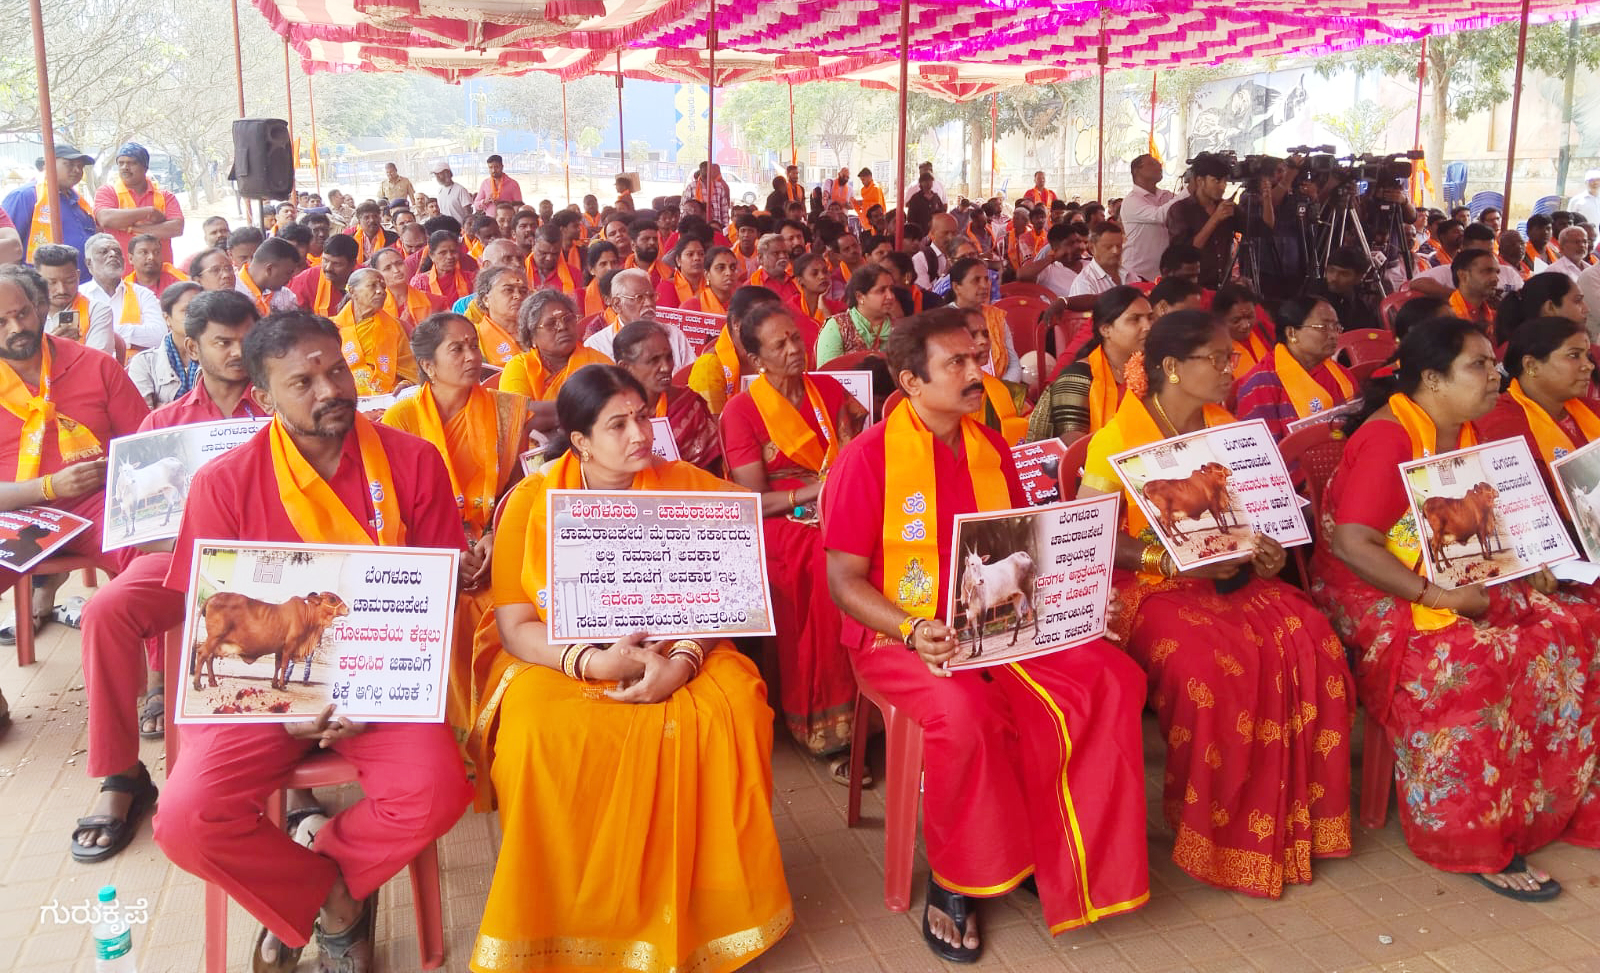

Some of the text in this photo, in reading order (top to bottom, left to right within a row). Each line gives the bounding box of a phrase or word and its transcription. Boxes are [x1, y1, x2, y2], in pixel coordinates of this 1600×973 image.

[572, 501, 637, 518] ಬೆಂಗಳೂರು
[659, 502, 739, 519] ಚಾಮರಾಜಪೇಟೆ
[1059, 508, 1099, 524] ಬೆಂಗಳೂರು
[560, 525, 643, 540] ಚಾಮರಾಜಪೇಟೆ
[649, 526, 690, 547] ಮೈದಾನ
[1051, 523, 1103, 545] ಚಾಮರಾಜಪೇಟೆ
[678, 549, 720, 562] ಅವಕಾಶ
[365, 565, 422, 585] ಬೆಂಗಳೂರು
[580, 568, 737, 586] ಗಣೇಶ ಪೂಜೆಗೆ ಅವಕಾಶ ಇಲ್ಲ
[353, 595, 429, 614] ಚಾಮರಾಜಪೇಟೆ
[601, 590, 643, 606] ಇದೇನಾ
[614, 611, 688, 626] ಮಹಾಶಯರೇ
[334, 622, 440, 652] ಗೋಮಾತೆಯ ಕೆಚ್ಚಲು
[1035, 631, 1060, 645] ಯಾರು
[339, 653, 384, 677] ಕತ್ತರಿಸಿದ
[388, 682, 420, 701] ಯಾಕೆ
[426, 683, 433, 701] ?
